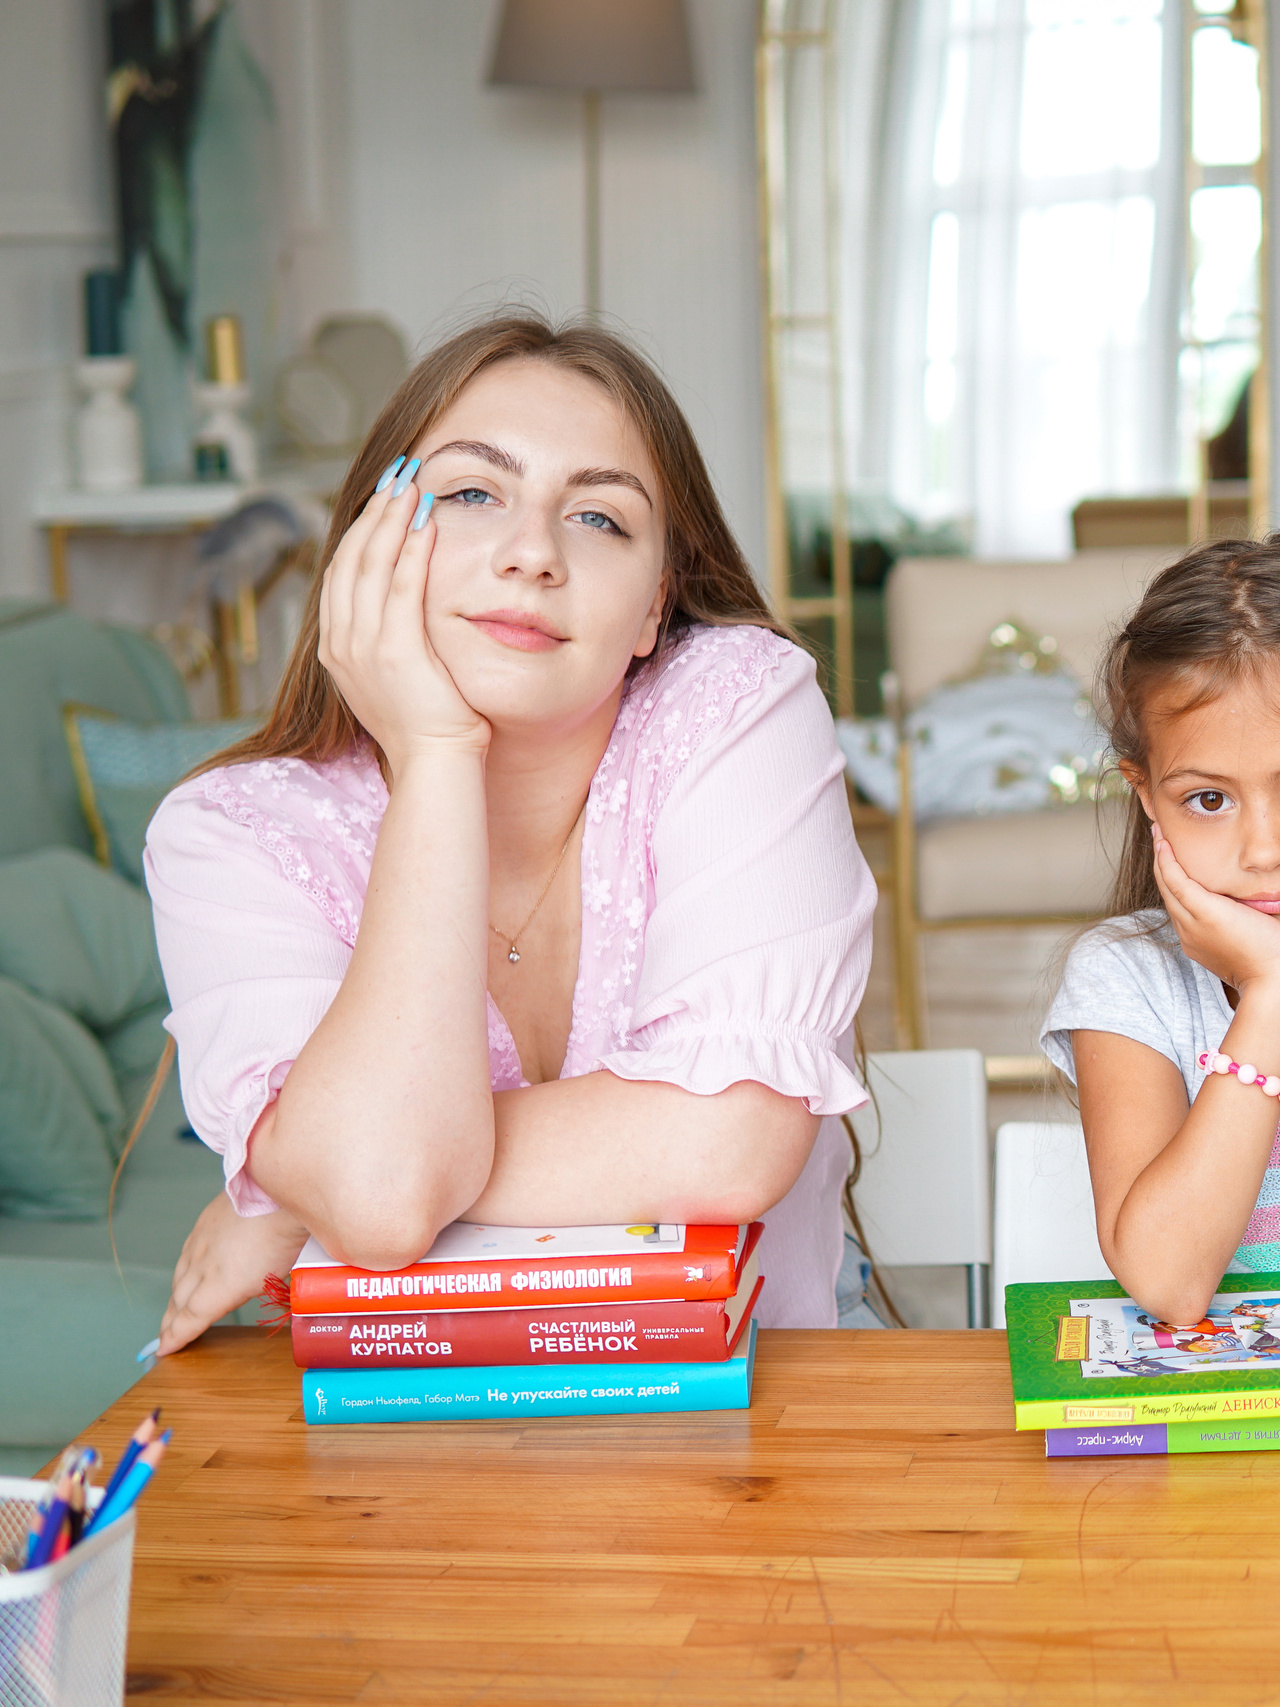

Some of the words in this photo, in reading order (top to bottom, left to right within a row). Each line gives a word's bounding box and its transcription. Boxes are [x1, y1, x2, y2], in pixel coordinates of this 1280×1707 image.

[346, 1272, 502, 1299] ПЕДАГОГИЧЕСКАЯ
[510, 1267, 633, 1291] ФИЗИОЛОГИЯ
[309, 1325, 343, 1334] ДОКТОР
[349, 1321, 427, 1340] АНДРЕЙ
[528, 1319, 636, 1335] СЧАСТЛИВЫЙ
[351, 1342, 453, 1356] КУРПАТОВ
[529, 1334, 639, 1353] РЕБЁНОК
[341, 1397, 374, 1408] Гордон
[424, 1393, 453, 1405] Габор
[455, 1393, 480, 1403] Матэ
[487, 1388, 508, 1402] Не
[511, 1386, 588, 1404] упускайте
[591, 1387, 634, 1398] своих
[637, 1382, 680, 1398] детей
[1141, 1404, 1171, 1416] Виктор
[1076, 1432, 1144, 1447] Айрис-пресс
[1200, 1430, 1242, 1441] детьми
[1245, 1431, 1251, 1440] с
